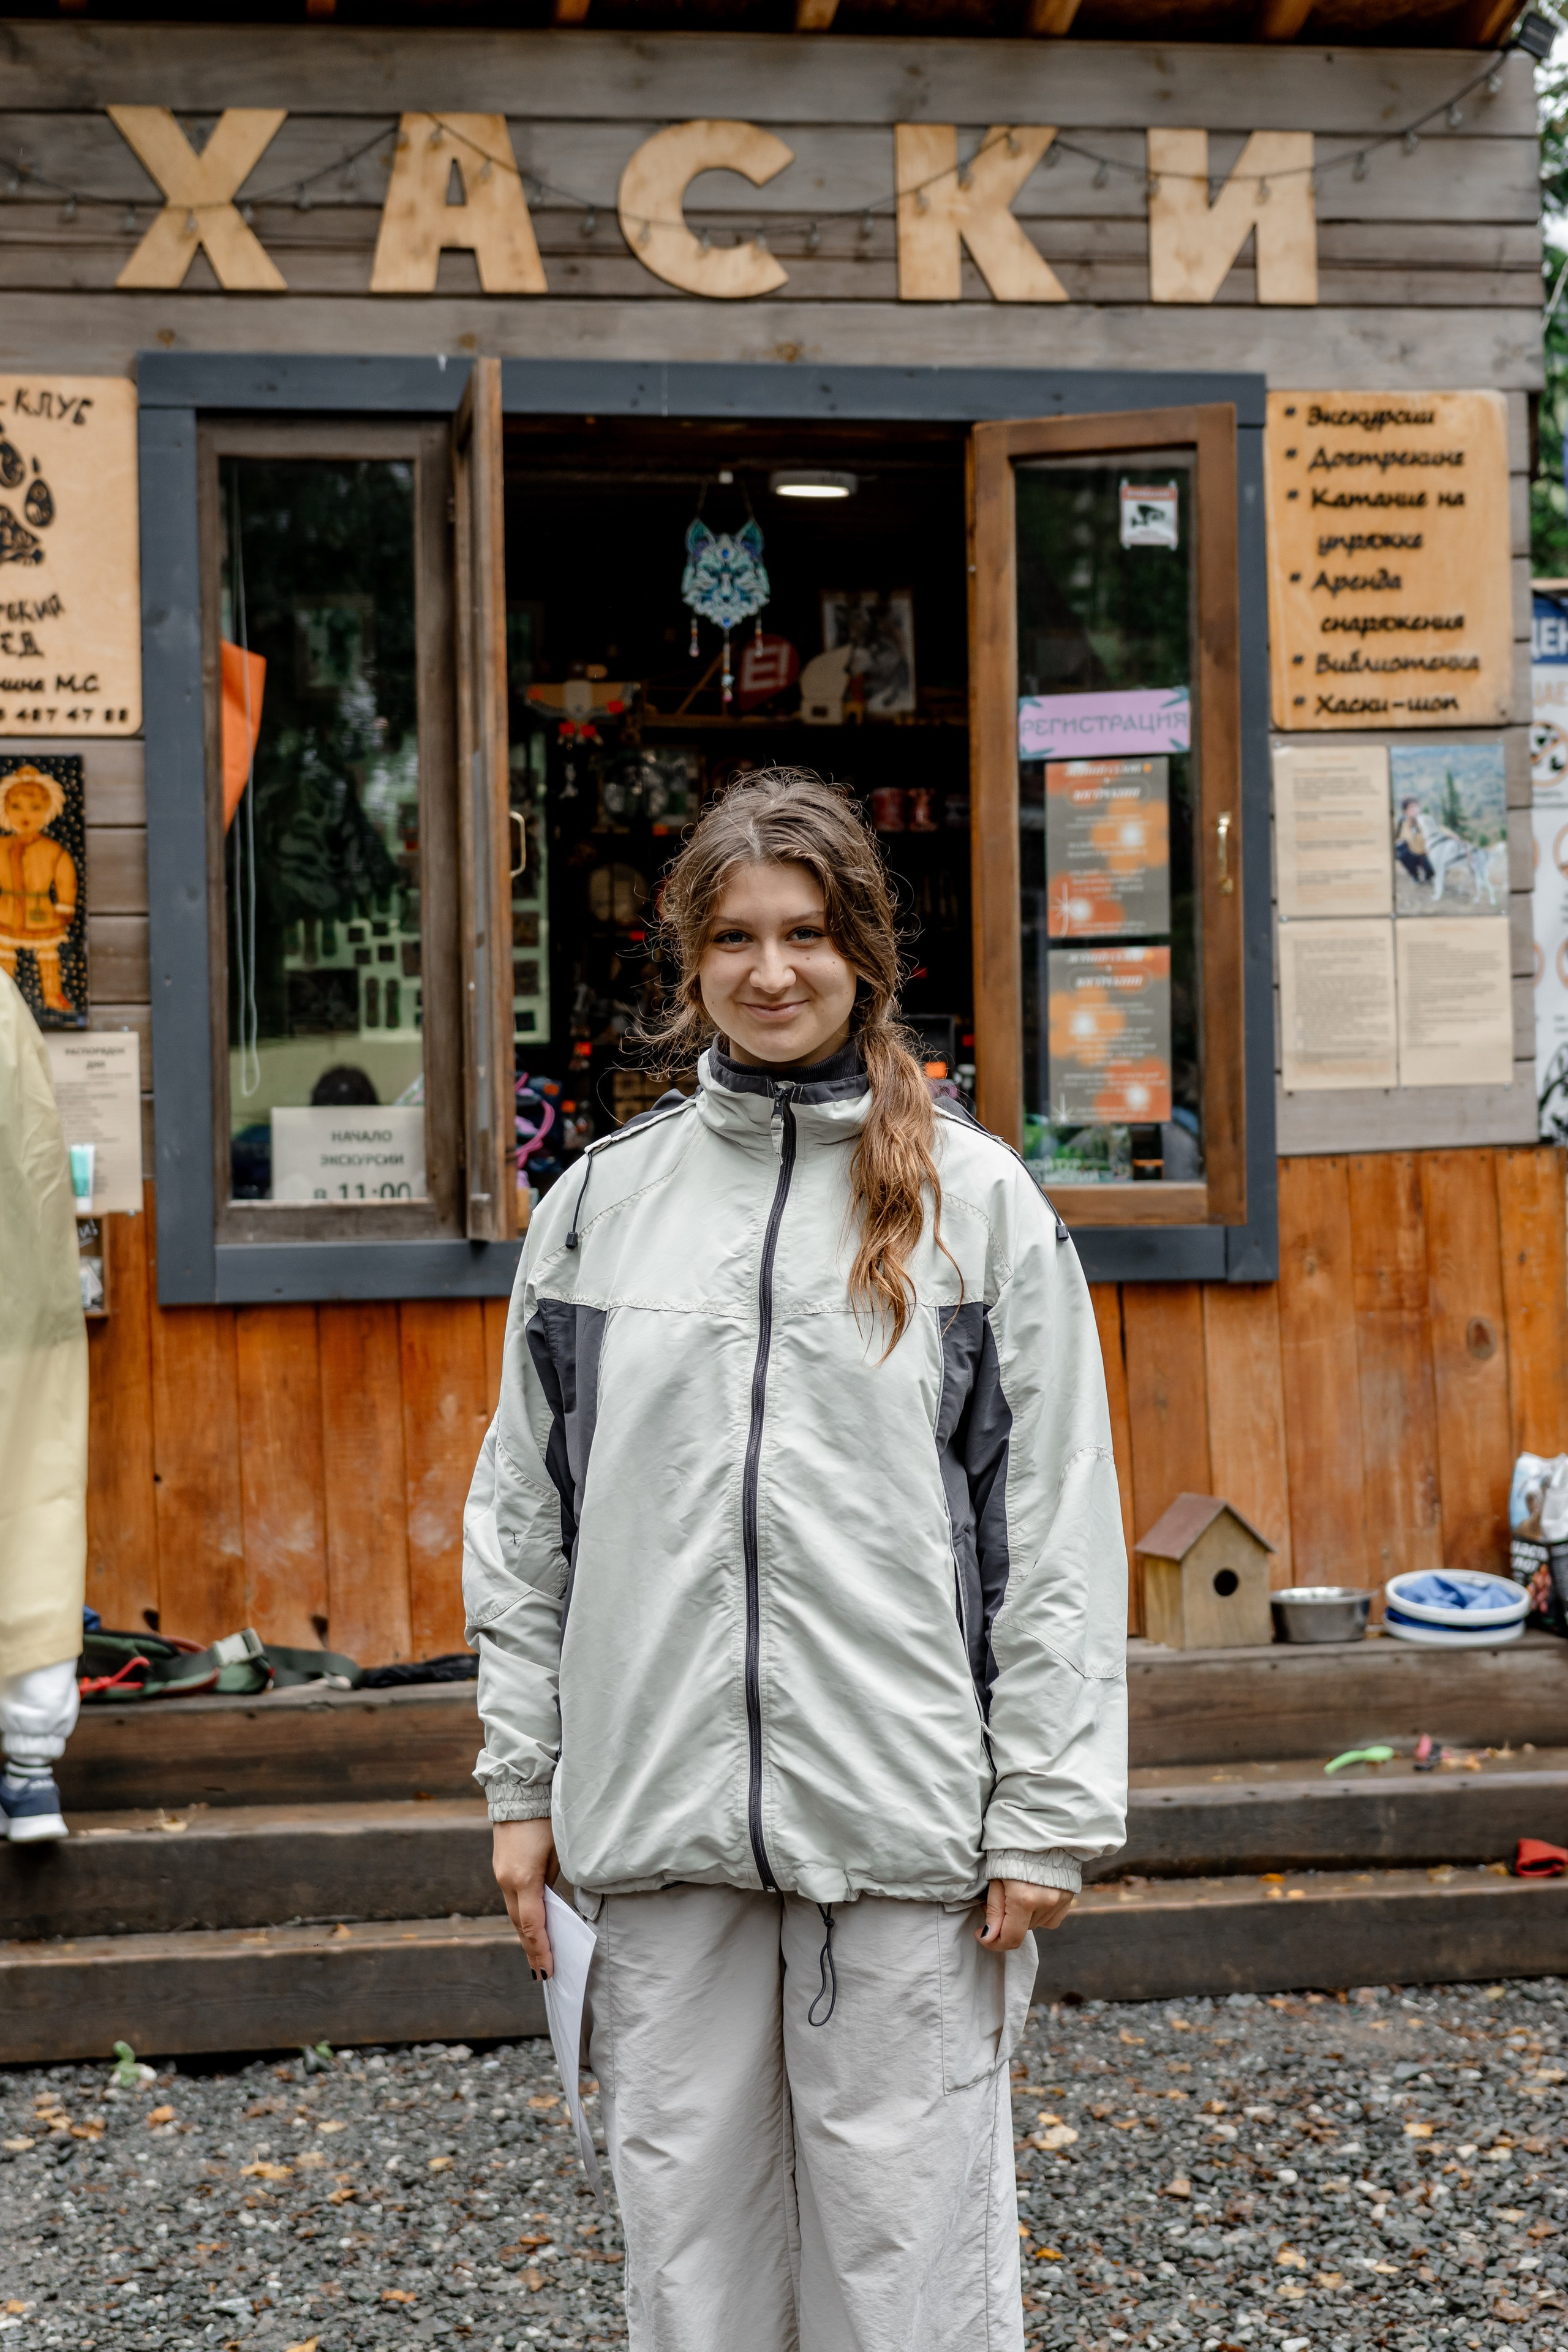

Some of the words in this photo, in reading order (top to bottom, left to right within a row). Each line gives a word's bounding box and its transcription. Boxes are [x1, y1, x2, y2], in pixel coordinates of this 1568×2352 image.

[105, 105, 1318, 305] ХАСКИ
[0, 387, 94, 425] -КЛУБ
[1307, 405, 1436, 431] Экскурсии
[1311, 488, 1427, 508] Катание
[1438, 492, 1466, 508] на
[1318, 533, 1423, 557] упряжке
[1312, 567, 1401, 596] Аренда
[1320, 614, 1465, 638] снаряжения
[0, 630, 44, 658] ЕД
[67, 708, 94, 722] 47
[1315, 694, 1459, 715] Хаски-шоп
[1022, 712, 1188, 736] РЕГИСТРАЦИЯ
[332, 1129, 393, 1143] НАЧАЛО
[321, 1153, 404, 1167] ЭКСКУРСИИ
